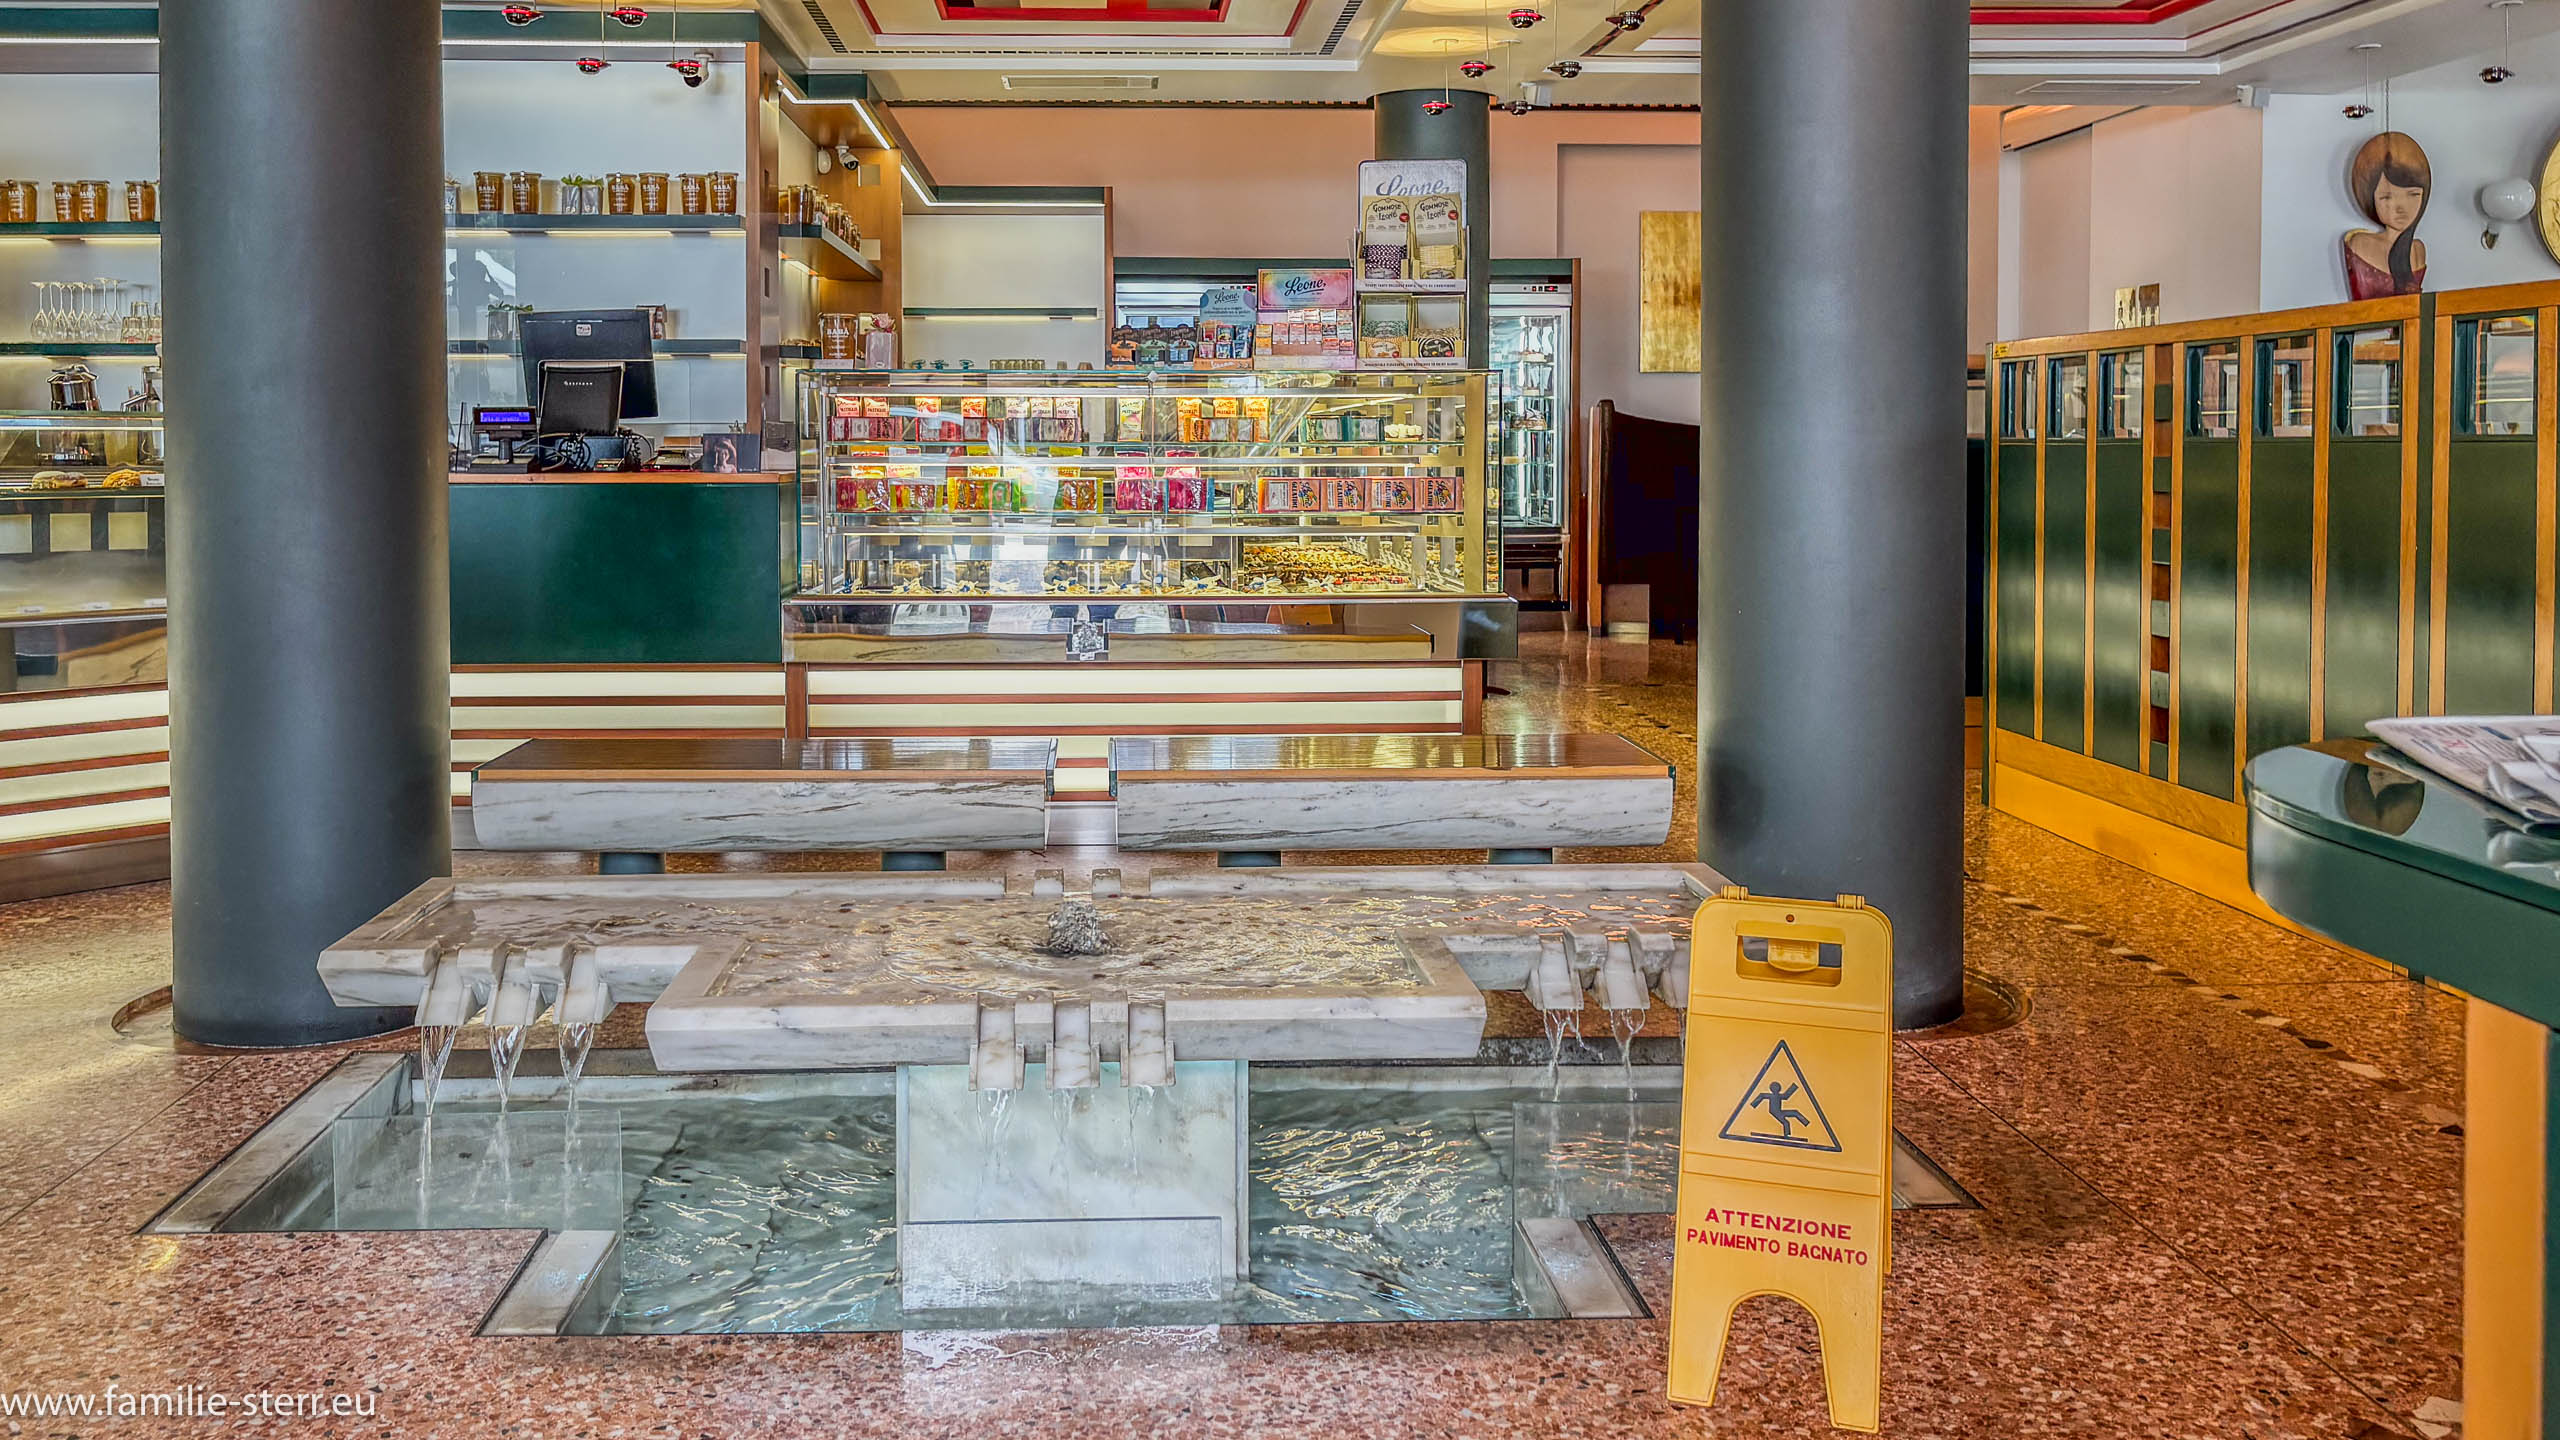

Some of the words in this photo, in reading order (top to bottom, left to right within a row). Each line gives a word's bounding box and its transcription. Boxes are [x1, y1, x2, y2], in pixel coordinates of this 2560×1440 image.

[1284, 276, 1326, 296] Leone
[1704, 1207, 1853, 1241] ATTENZIONE
[1687, 1228, 1781, 1254] PAVIMENTO
[1787, 1241, 1868, 1266] BAGNATO
